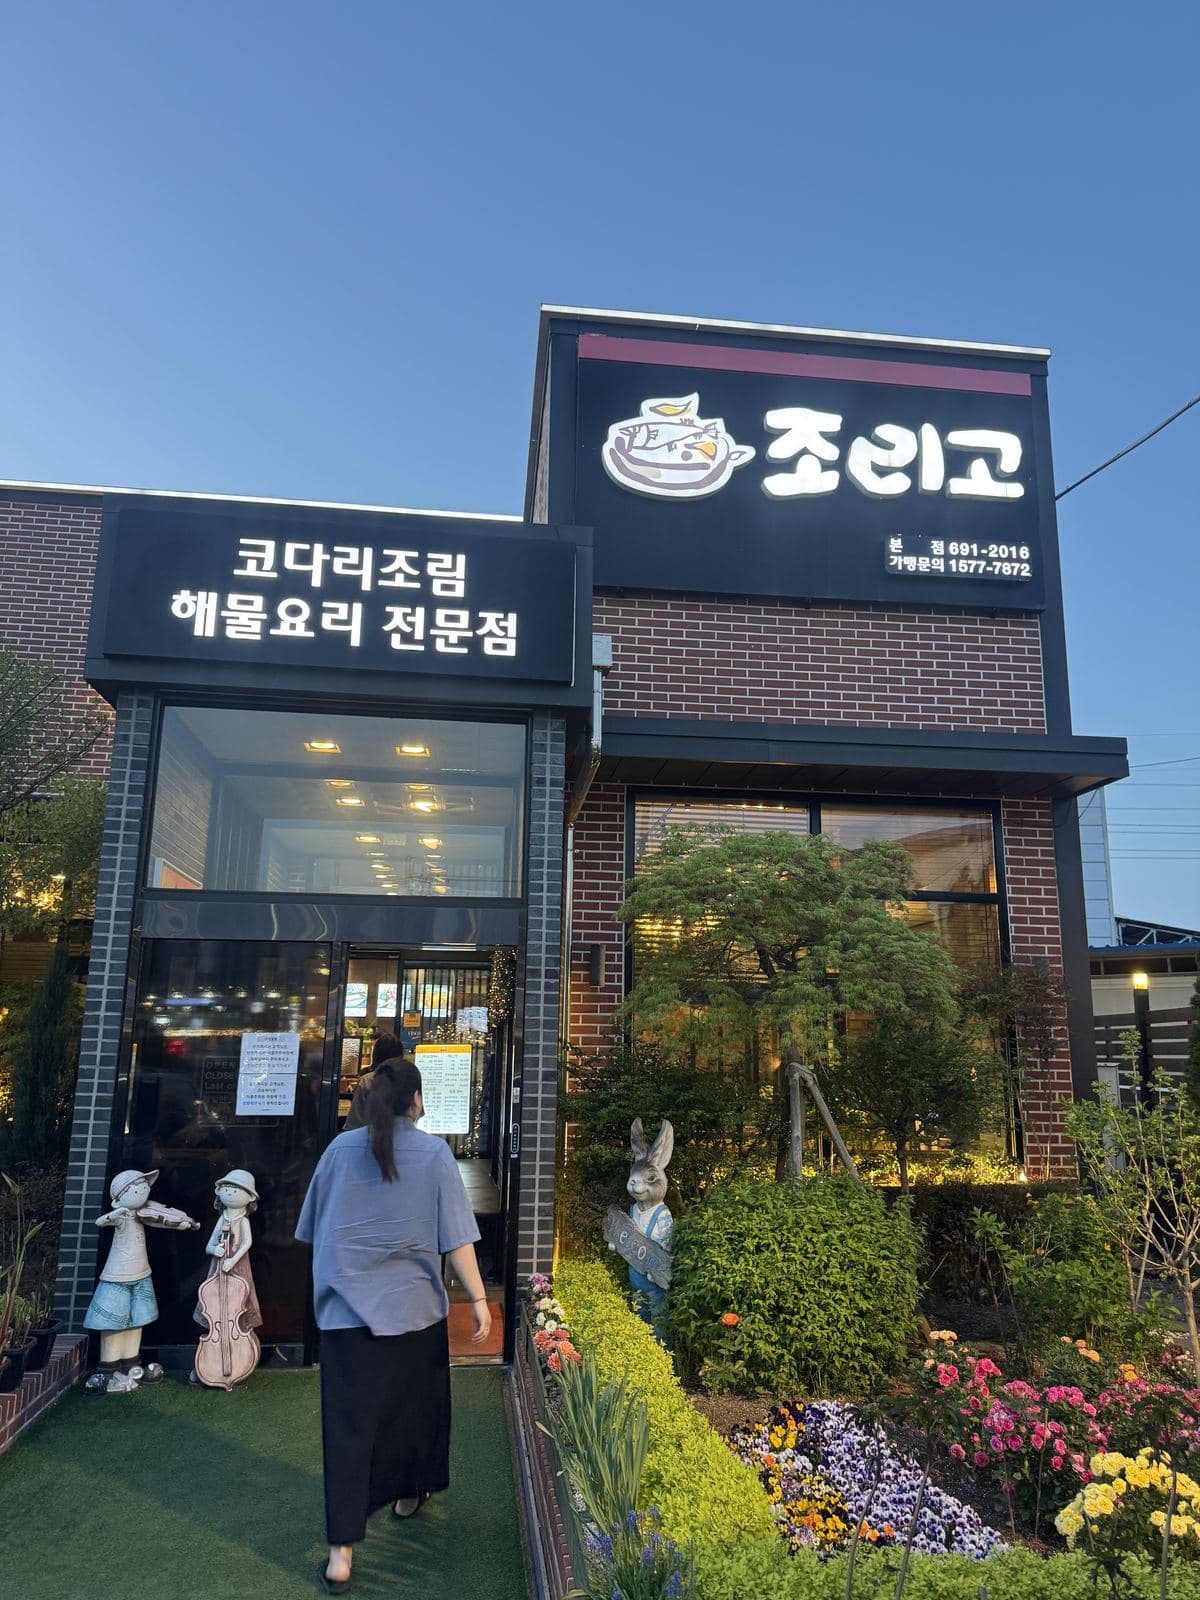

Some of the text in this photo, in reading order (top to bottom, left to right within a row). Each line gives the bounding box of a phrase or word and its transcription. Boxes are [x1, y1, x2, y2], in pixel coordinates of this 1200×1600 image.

[762, 406, 1025, 499] 조리고
[233, 537, 466, 598] 코다리조림
[889, 555, 1032, 577] 가맹문의 1577-7872
[948, 541, 1030, 560] 691-2016
[170, 589, 518, 657] 해물요리 전문점
[205, 1071, 235, 1080] CLOSE
